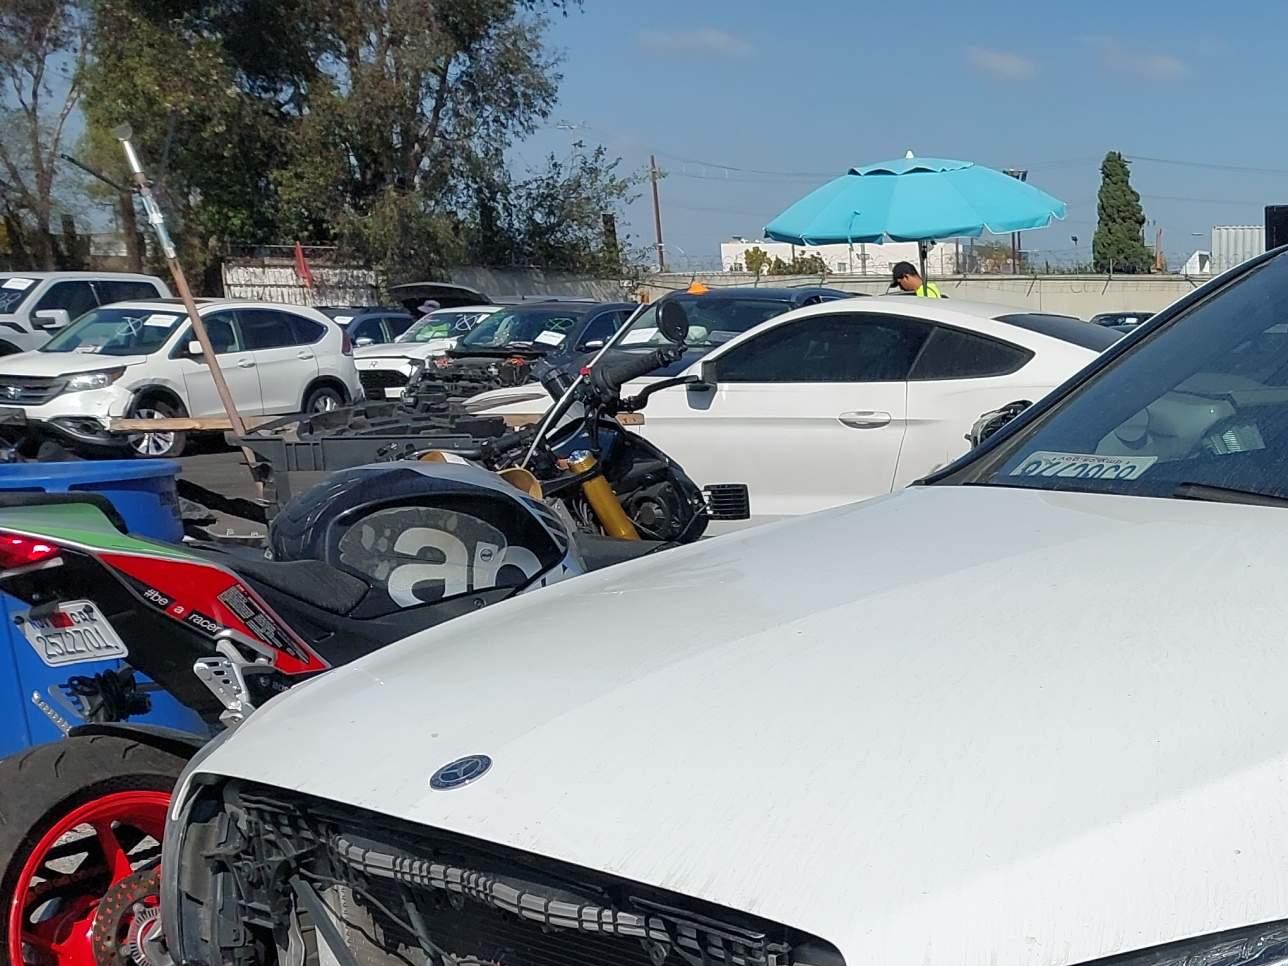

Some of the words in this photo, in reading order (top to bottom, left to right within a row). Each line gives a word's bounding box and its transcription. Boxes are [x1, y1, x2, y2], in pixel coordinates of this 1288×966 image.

[143, 588, 169, 606] #be
[173, 606, 185, 614] a
[188, 613, 222, 633] racer
